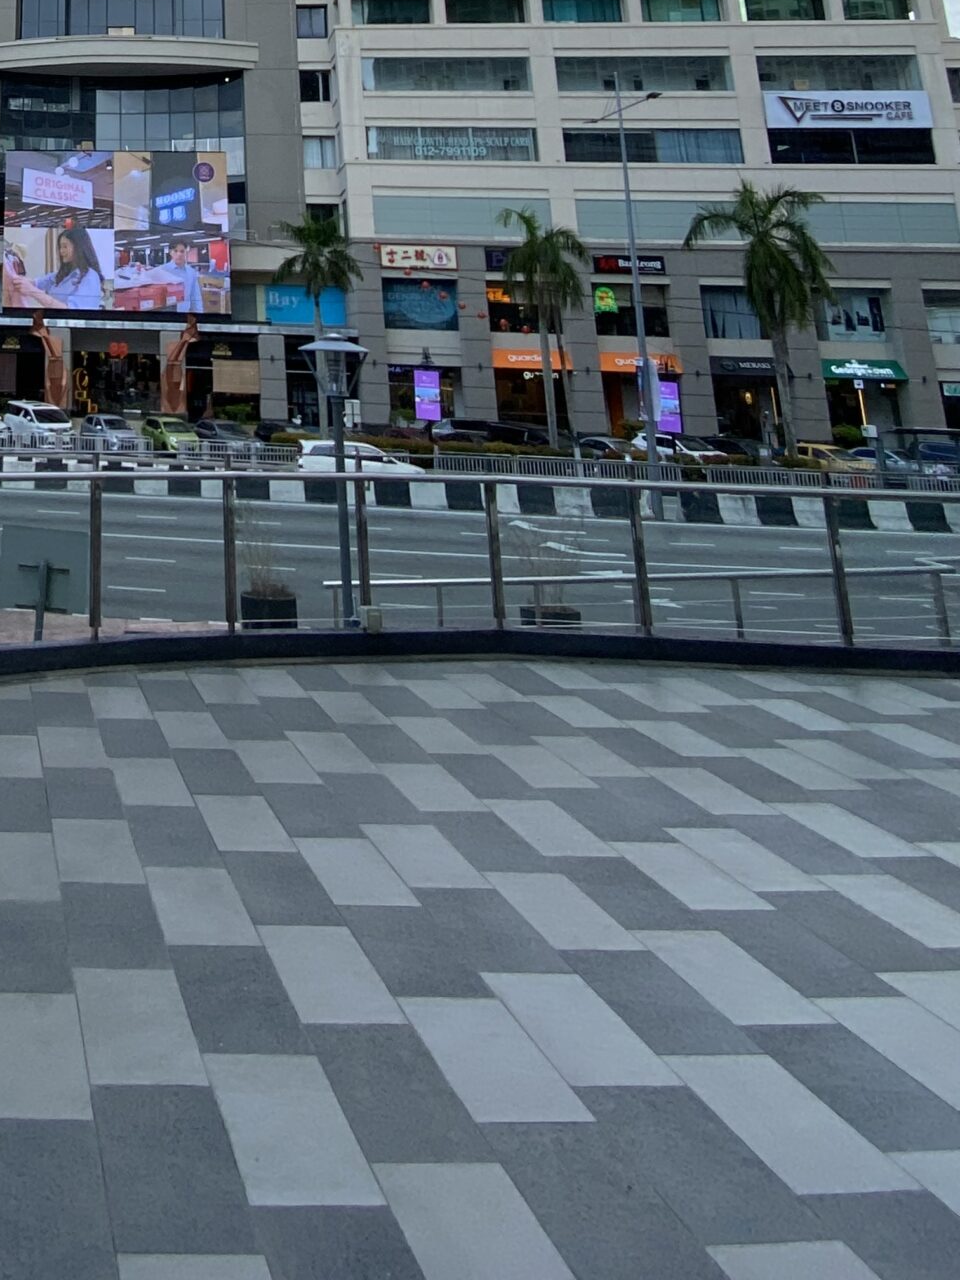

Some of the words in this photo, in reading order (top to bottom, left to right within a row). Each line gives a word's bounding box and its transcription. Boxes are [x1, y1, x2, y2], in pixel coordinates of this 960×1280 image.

[793, 101, 829, 112] MEET
[846, 101, 912, 111] SNOOKER
[886, 112, 913, 120] CAFE
[34, 176, 86, 194] ORIGINAL
[34, 188, 79, 202] CLASSIC
[269, 291, 300, 308] Bay
